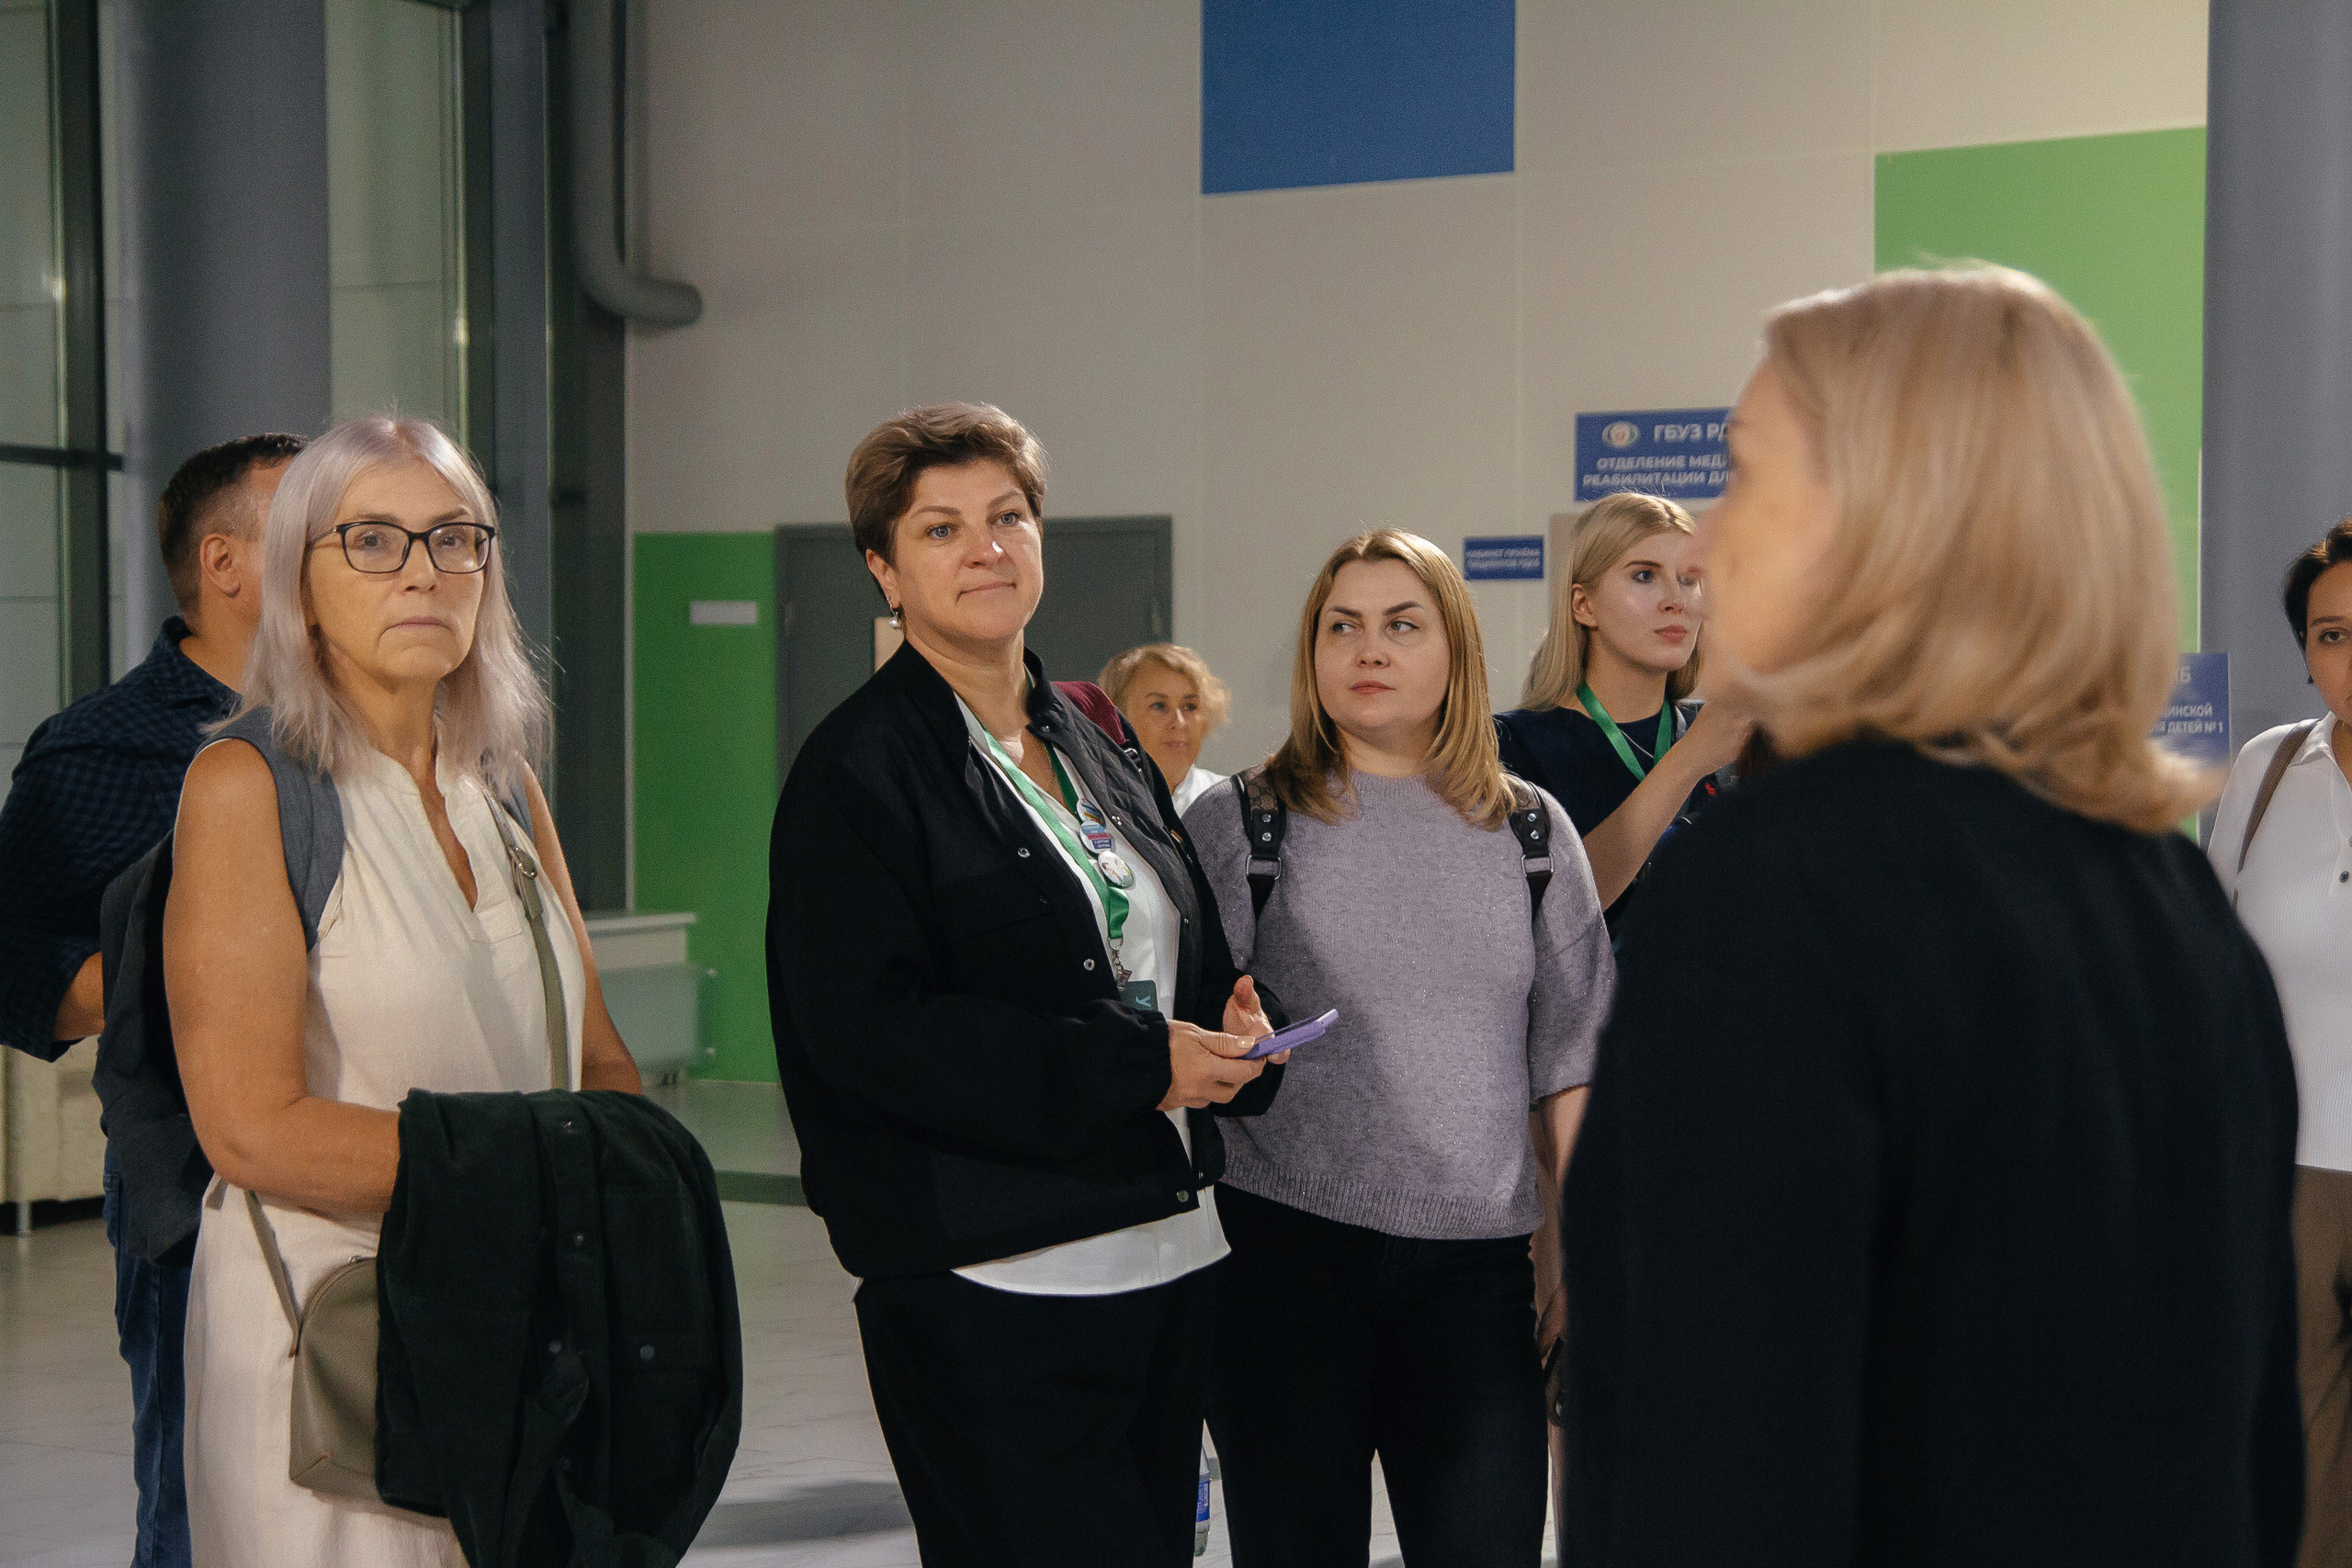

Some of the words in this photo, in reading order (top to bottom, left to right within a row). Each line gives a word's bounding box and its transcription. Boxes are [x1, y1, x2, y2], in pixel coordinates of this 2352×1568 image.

[1654, 423, 1702, 442] ГБУЗ
[1596, 455, 1686, 470] ОТДЕЛЕНИЕ
[1582, 471, 1705, 487] РЕАБИЛИТАЦИИ
[2167, 718, 2203, 734] ДЕТЕЙ
